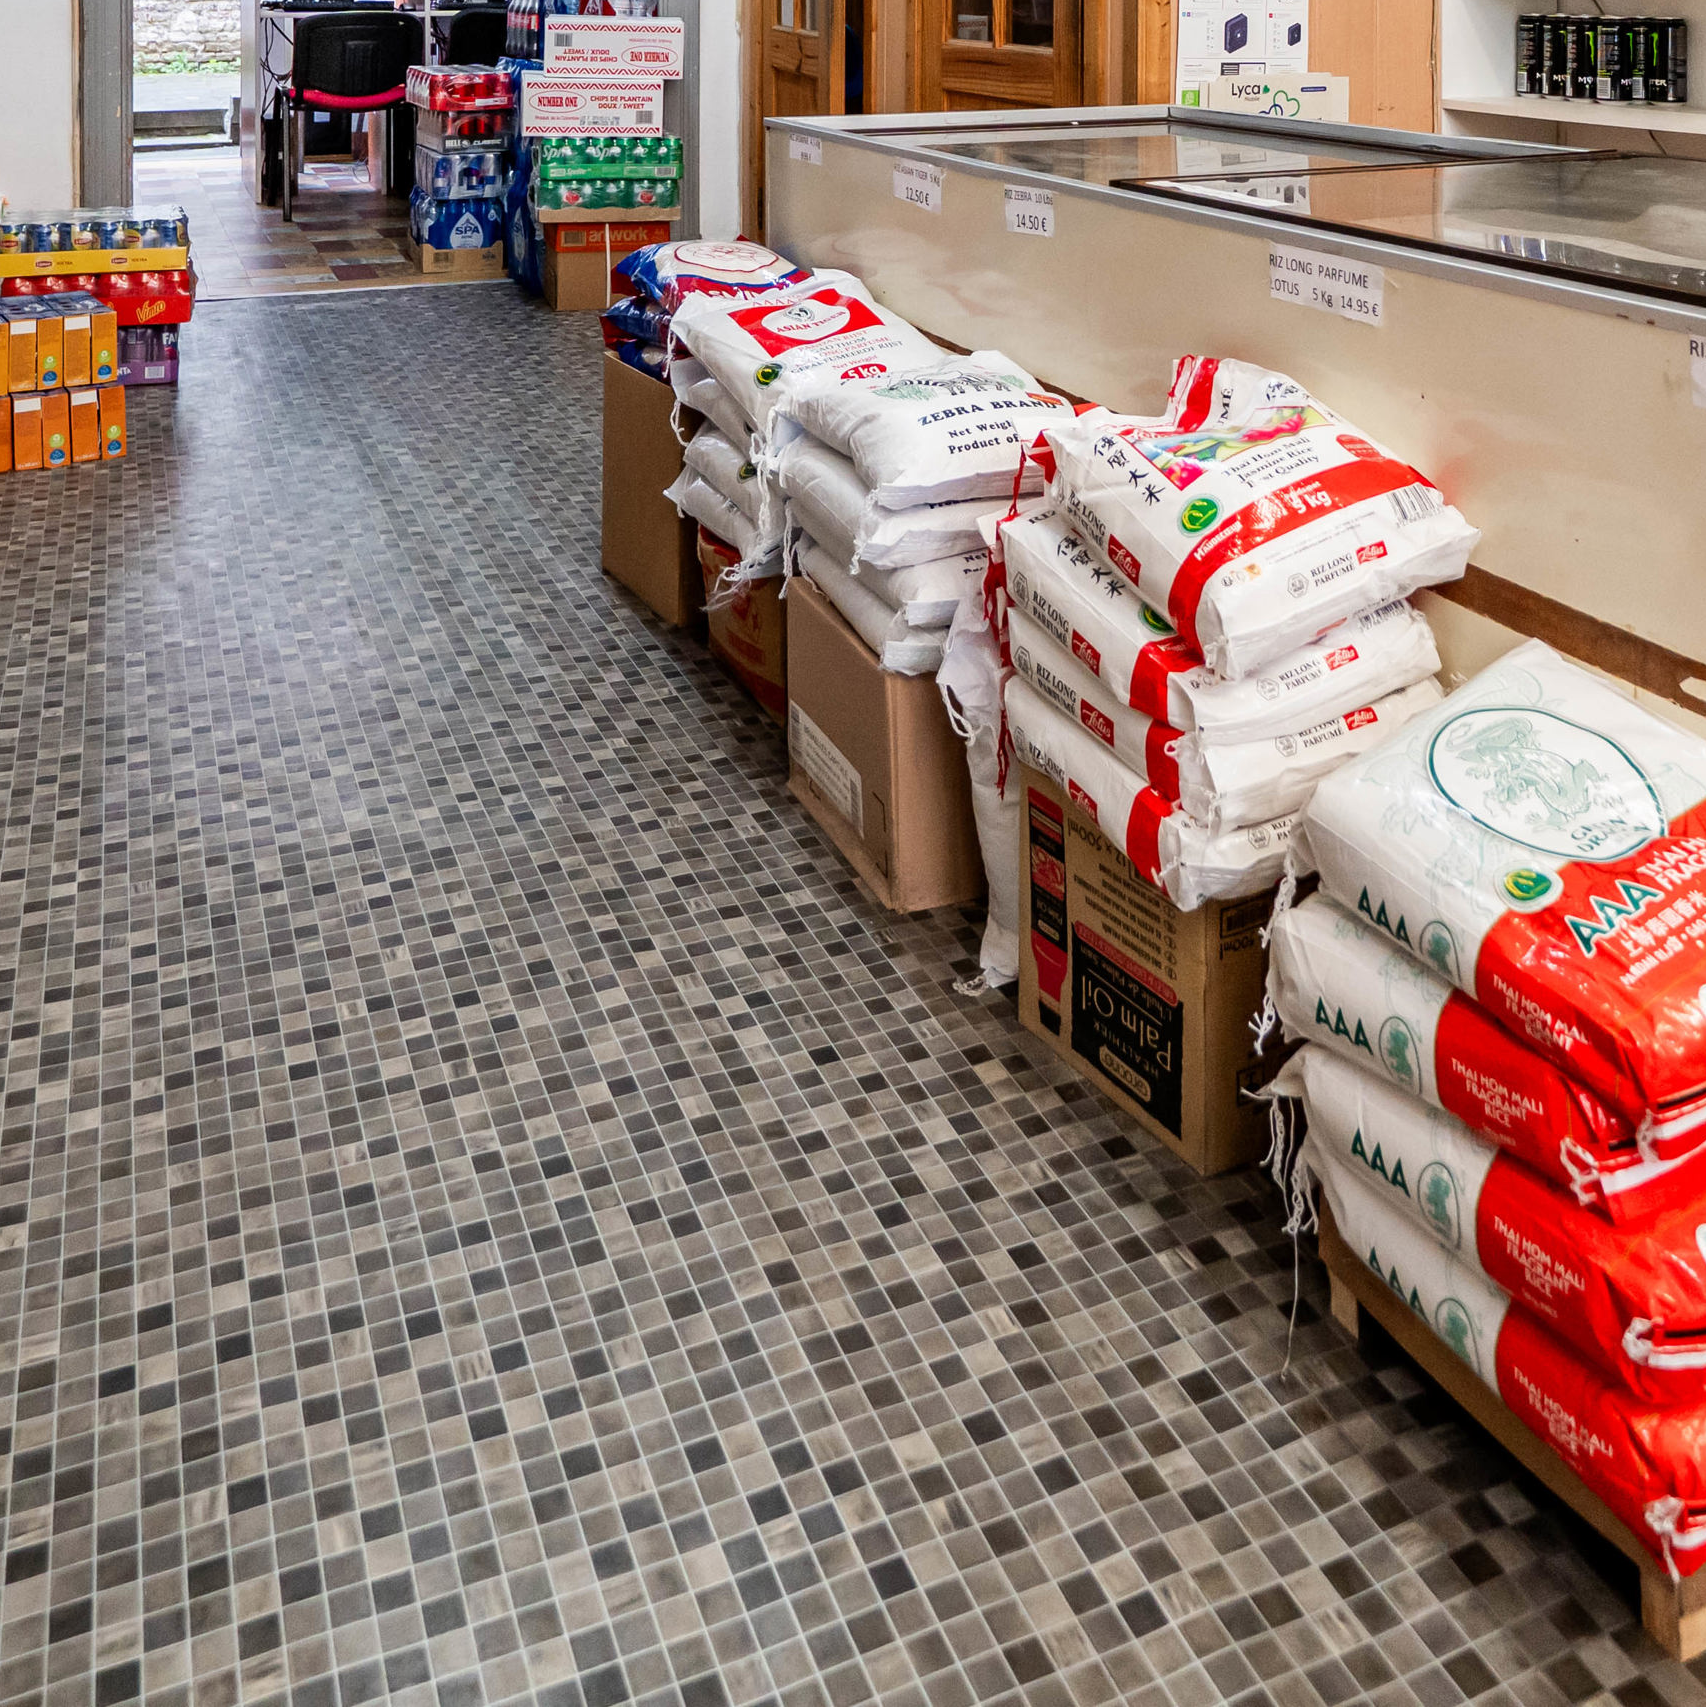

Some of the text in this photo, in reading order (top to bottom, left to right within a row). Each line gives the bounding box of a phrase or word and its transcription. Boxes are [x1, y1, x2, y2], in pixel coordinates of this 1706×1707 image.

[538, 97, 578, 107] NUMBER ONE
[1232, 83, 1261, 98] Lyca
[906, 186, 930, 206] 12.50 €
[1014, 191, 1054, 206] ZEBRA 10 Lbs
[455, 226, 480, 236] SPA
[1016, 213, 1048, 231] 14.50 €
[1269, 254, 1369, 289] RIZ LONG PARFUME
[1312, 288, 1319, 300] 5
[1320, 292, 1333, 307] Kg
[1341, 295, 1370, 314] 14.95
[1372, 303, 1380, 317] €
[776, 321, 812, 335] ASIAN
[859, 365, 881, 379] kg
[917, 393, 1058, 427] ZEBRA BRAND
[948, 428, 972, 444] Net
[948, 434, 1021, 462] Product of
[1093, 434, 1166, 507] 優質大米
[1238, 446, 1315, 486] Jasmine Rice
[1278, 455, 1321, 481] Quality
[1057, 534, 1127, 600] 優質大米
[1327, 552, 1354, 572] LONG
[1033, 590, 1070, 635] RIZ LONG
[1036, 662, 1076, 706] RIZ LONG
[1357, 885, 1414, 952] AAA
[1565, 878, 1666, 958] AAA
[1081, 975, 1171, 1073] Palm Oil
[1316, 996, 1374, 1056] AAA
[1451, 1057, 1544, 1116] THAI HOM MALI
[1466, 1079, 1526, 1122] FRAGRANT
[1485, 1103, 1512, 1128] RICE
[1352, 1128, 1411, 1199] AAA
[1554, 1261, 1586, 1291] MALI
